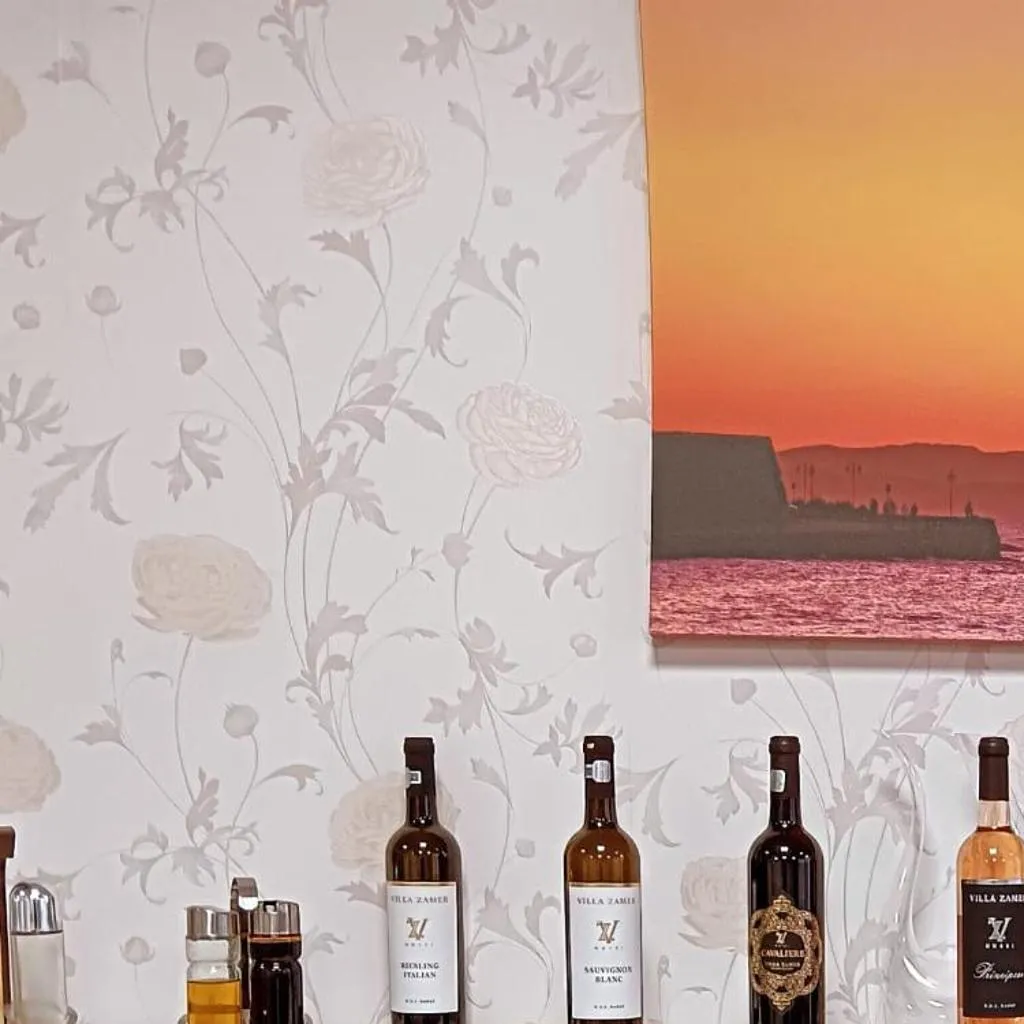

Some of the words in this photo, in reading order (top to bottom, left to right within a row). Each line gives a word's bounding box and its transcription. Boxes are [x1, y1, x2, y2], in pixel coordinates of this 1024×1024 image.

[577, 897, 604, 905] VILLA
[969, 893, 997, 903] VILLA
[583, 966, 633, 974] SAUVIGNON
[403, 971, 436, 979] ITALIAN
[595, 975, 624, 983] BLANC
